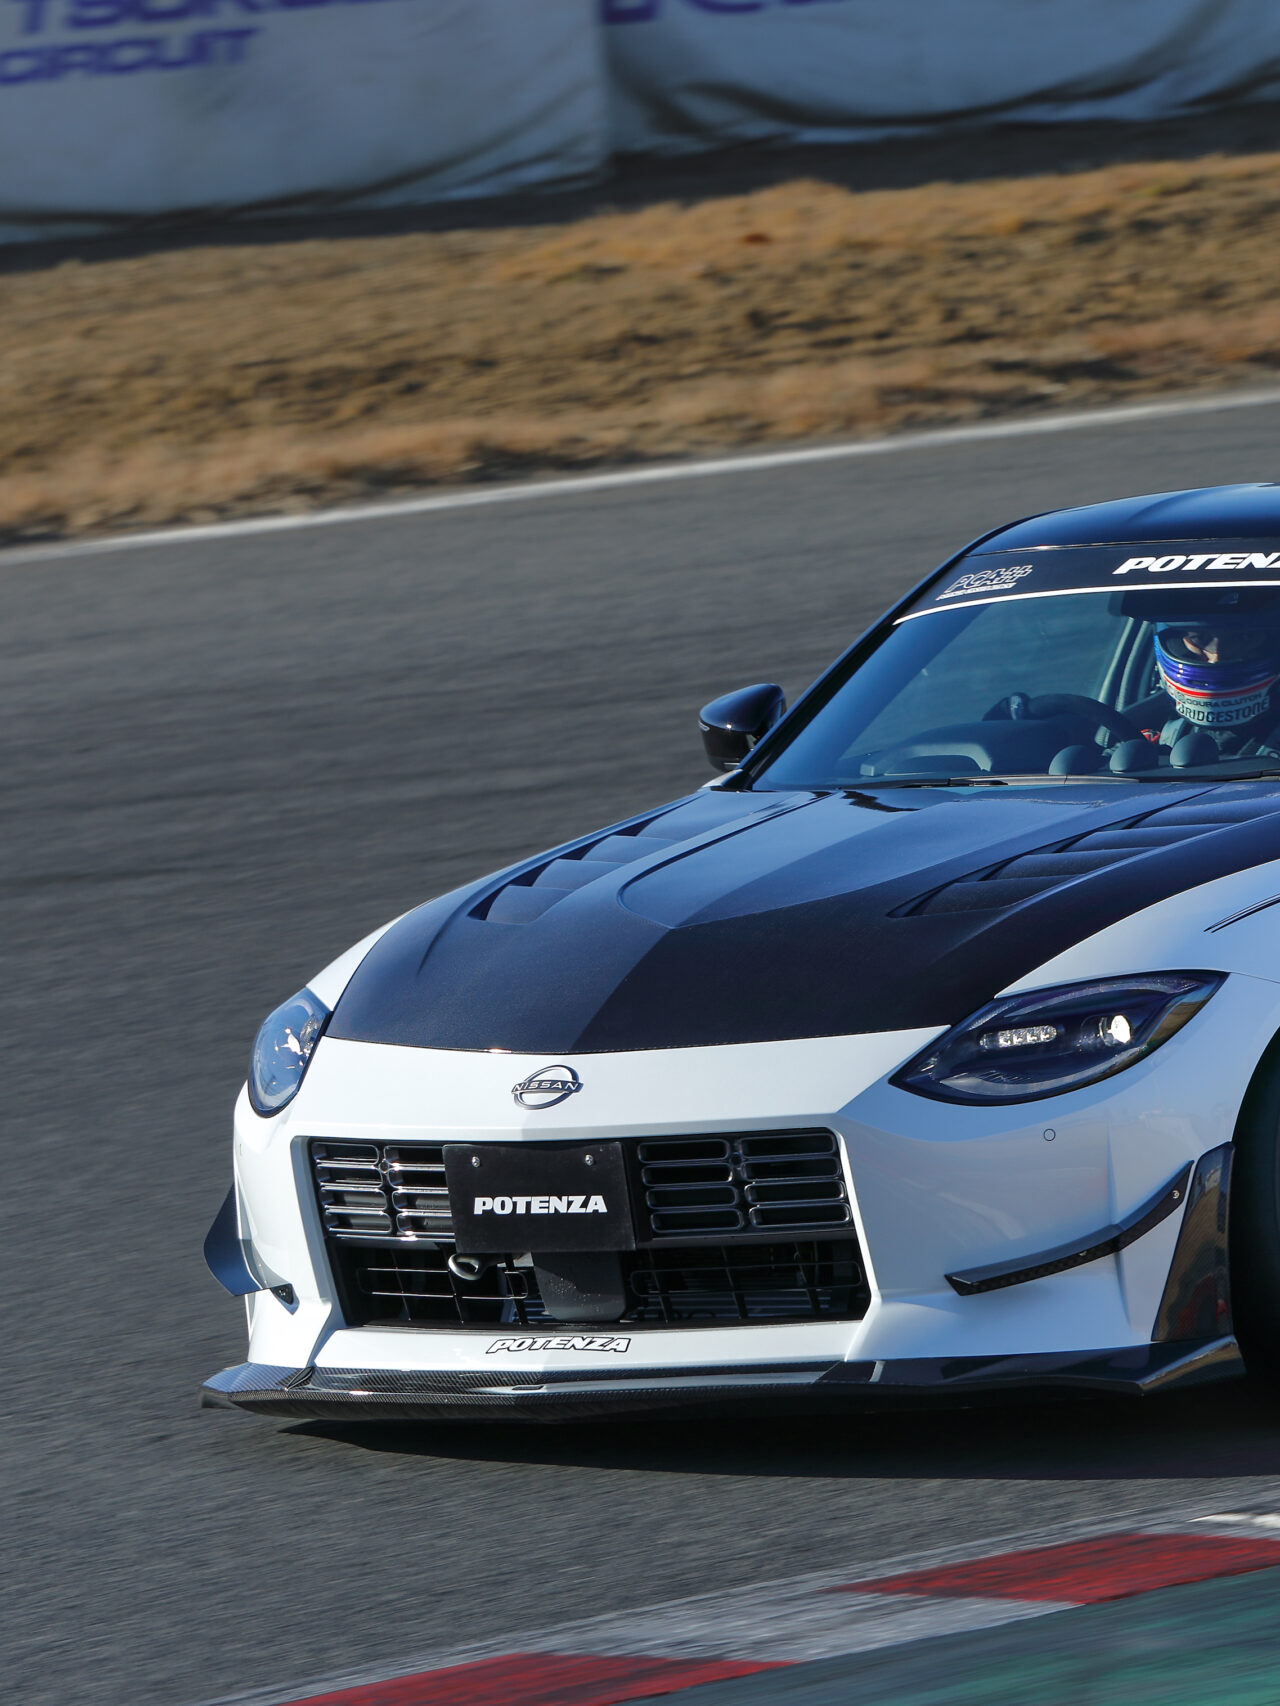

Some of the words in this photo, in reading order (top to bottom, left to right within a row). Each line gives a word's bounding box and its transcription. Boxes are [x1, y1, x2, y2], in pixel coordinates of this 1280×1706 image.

[0, 26, 262, 86] CIRCUIT
[1178, 698, 1269, 723] BRIDGESTONE
[512, 1081, 579, 1092] NISSAN
[473, 1195, 607, 1215] POTENZA
[486, 1336, 631, 1354] POTENZA
